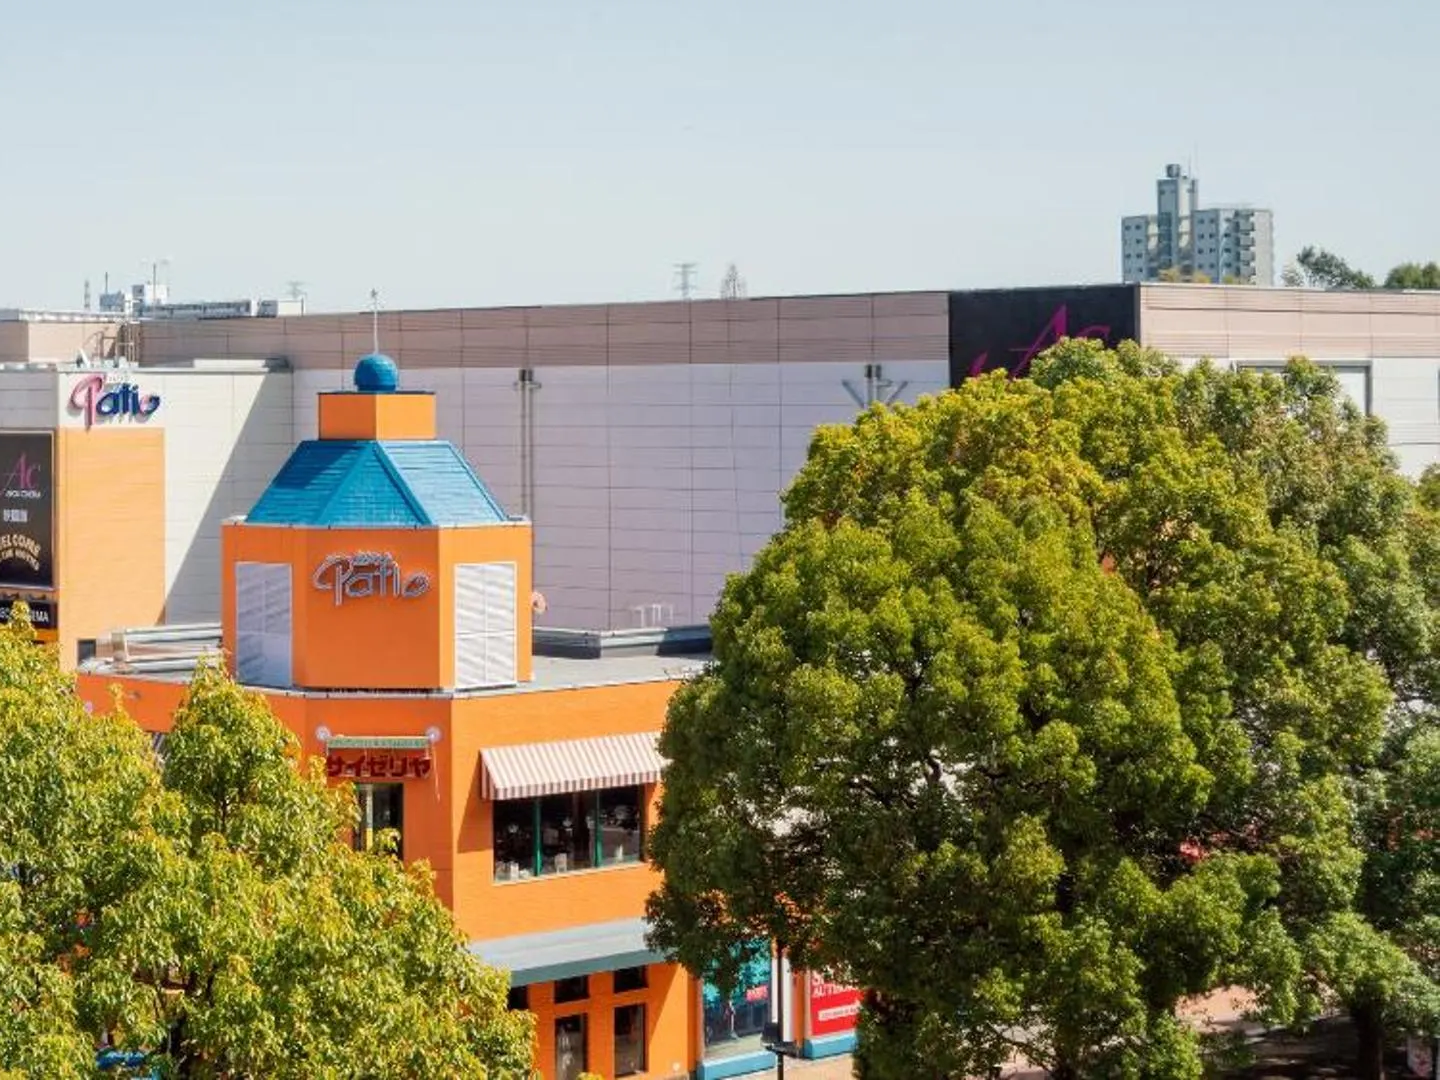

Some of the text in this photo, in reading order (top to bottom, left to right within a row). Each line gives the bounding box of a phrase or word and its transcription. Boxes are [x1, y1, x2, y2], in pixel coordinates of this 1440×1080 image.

[69, 375, 161, 426] Patio
[312, 555, 429, 606] Patio
[326, 754, 431, 778] サイゼリヤ
